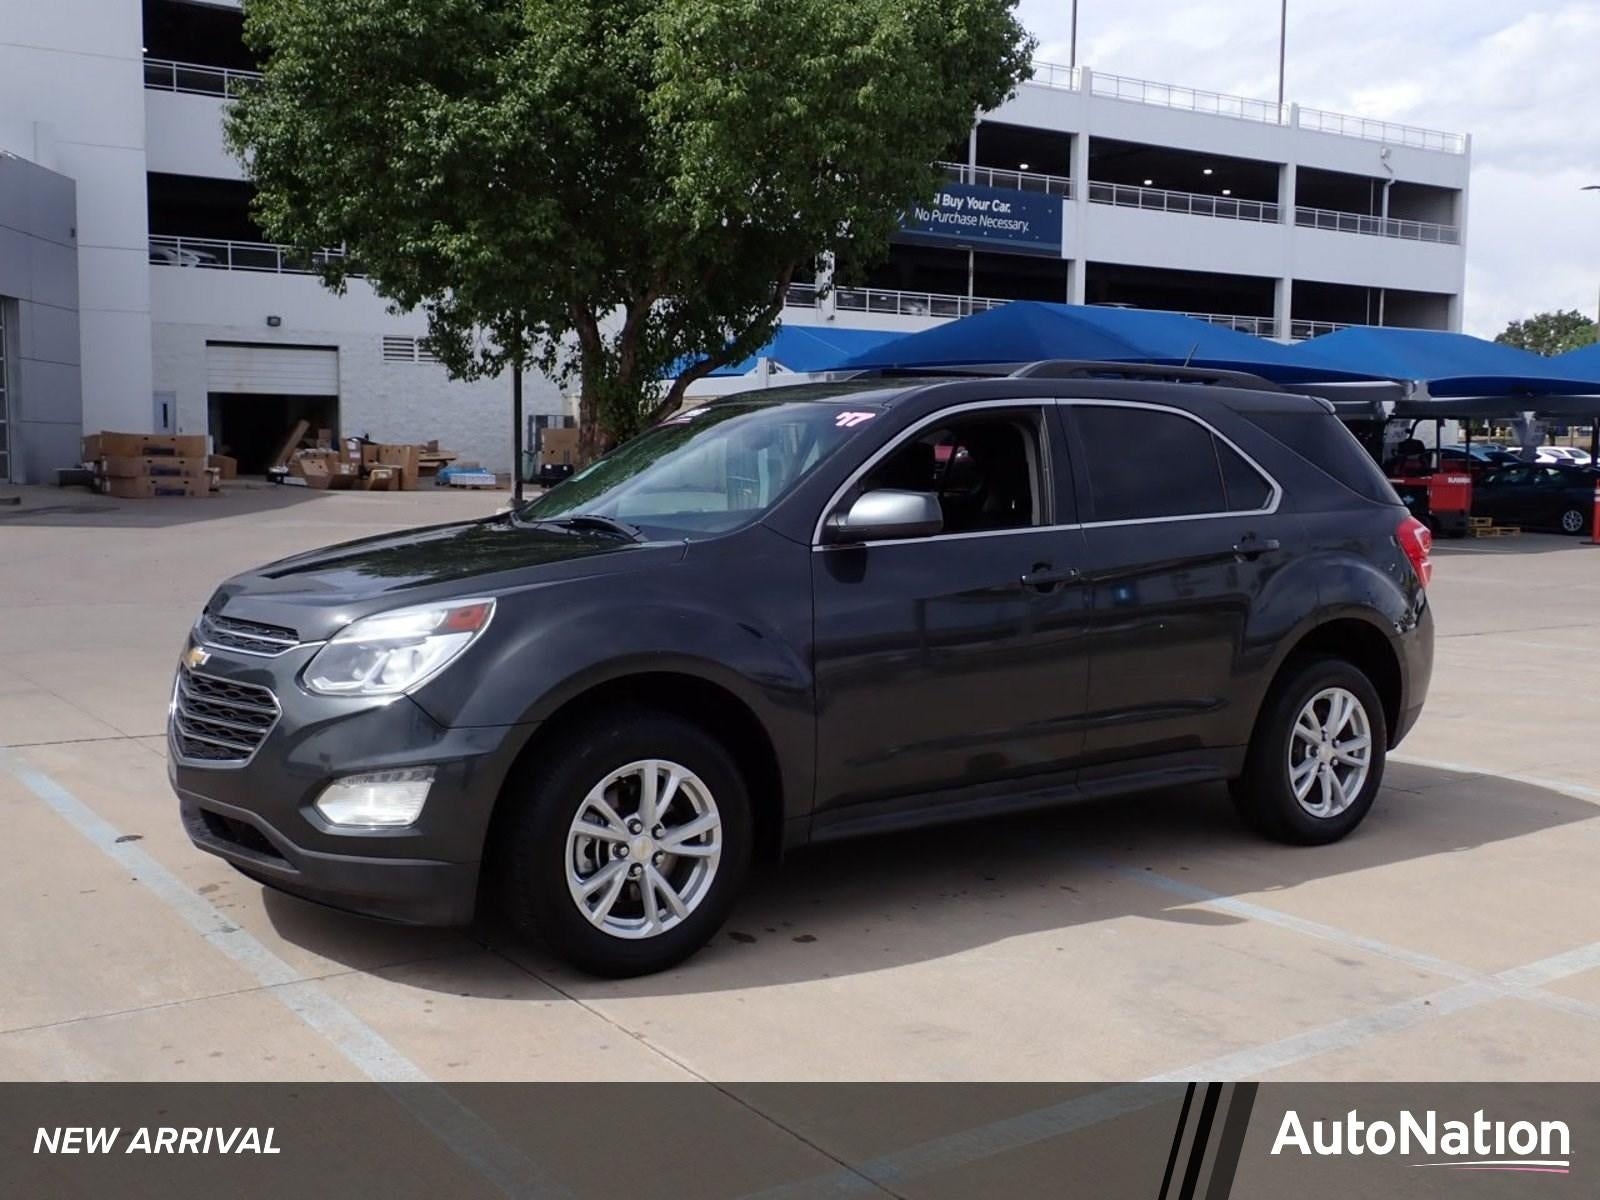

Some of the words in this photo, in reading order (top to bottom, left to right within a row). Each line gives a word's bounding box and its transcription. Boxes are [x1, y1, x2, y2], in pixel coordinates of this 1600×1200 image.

[942, 193, 964, 211] Buy
[966, 196, 991, 210] Your
[992, 199, 1011, 213] Car.
[914, 207, 930, 221] No
[931, 209, 977, 226] Purchase
[979, 214, 1029, 234] Necessary.
